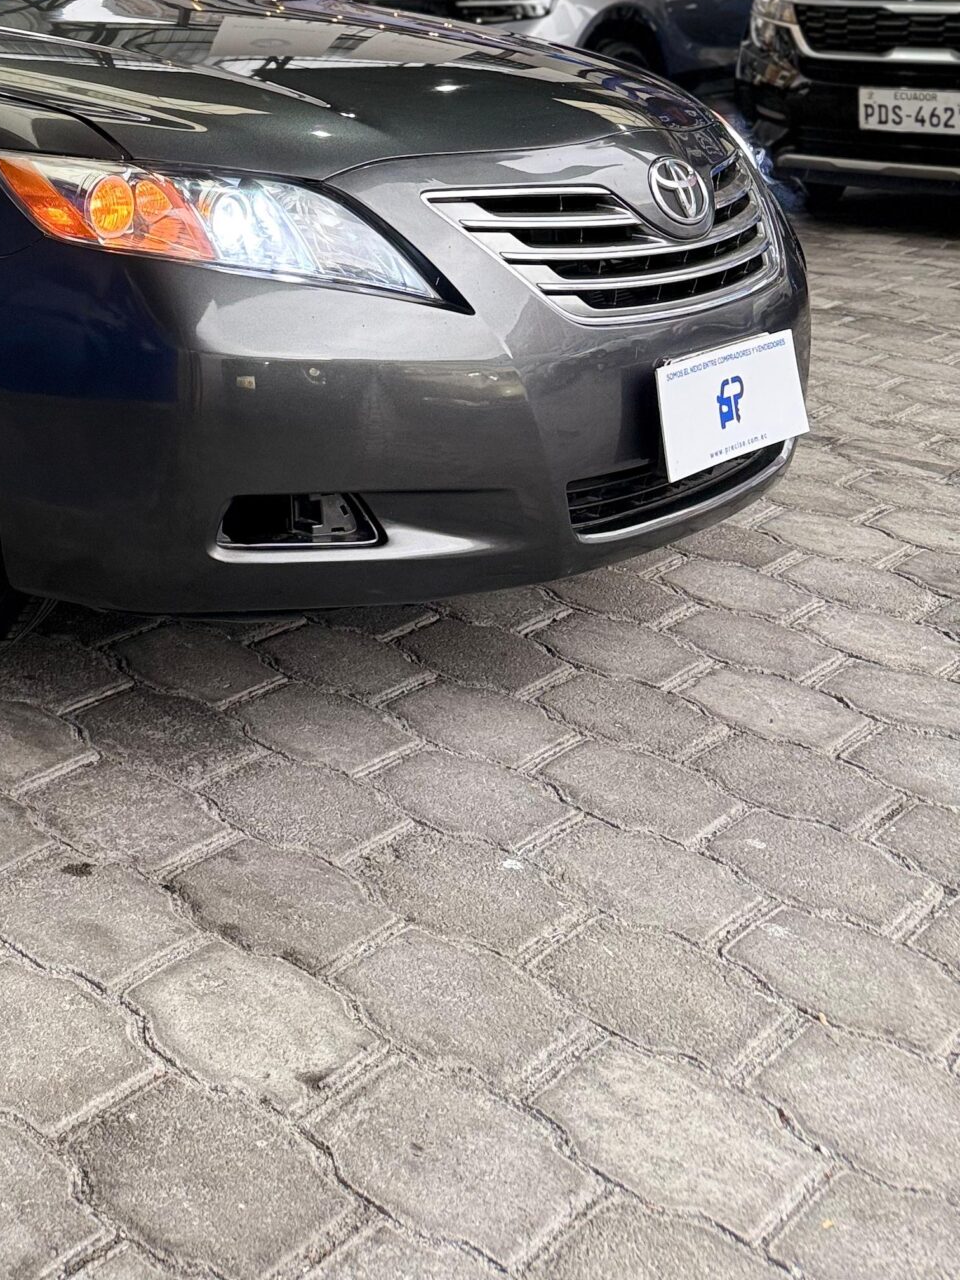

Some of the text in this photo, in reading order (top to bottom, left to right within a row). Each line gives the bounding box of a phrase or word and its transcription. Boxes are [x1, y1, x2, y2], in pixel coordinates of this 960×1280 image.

[894, 91, 938, 102] ECUADOR
[863, 103, 960, 129] PDS-462
[666, 370, 683, 381] SOMOS
[717, 349, 752, 365] COMPRADORES
[755, 338, 786, 353] VENDEDORES
